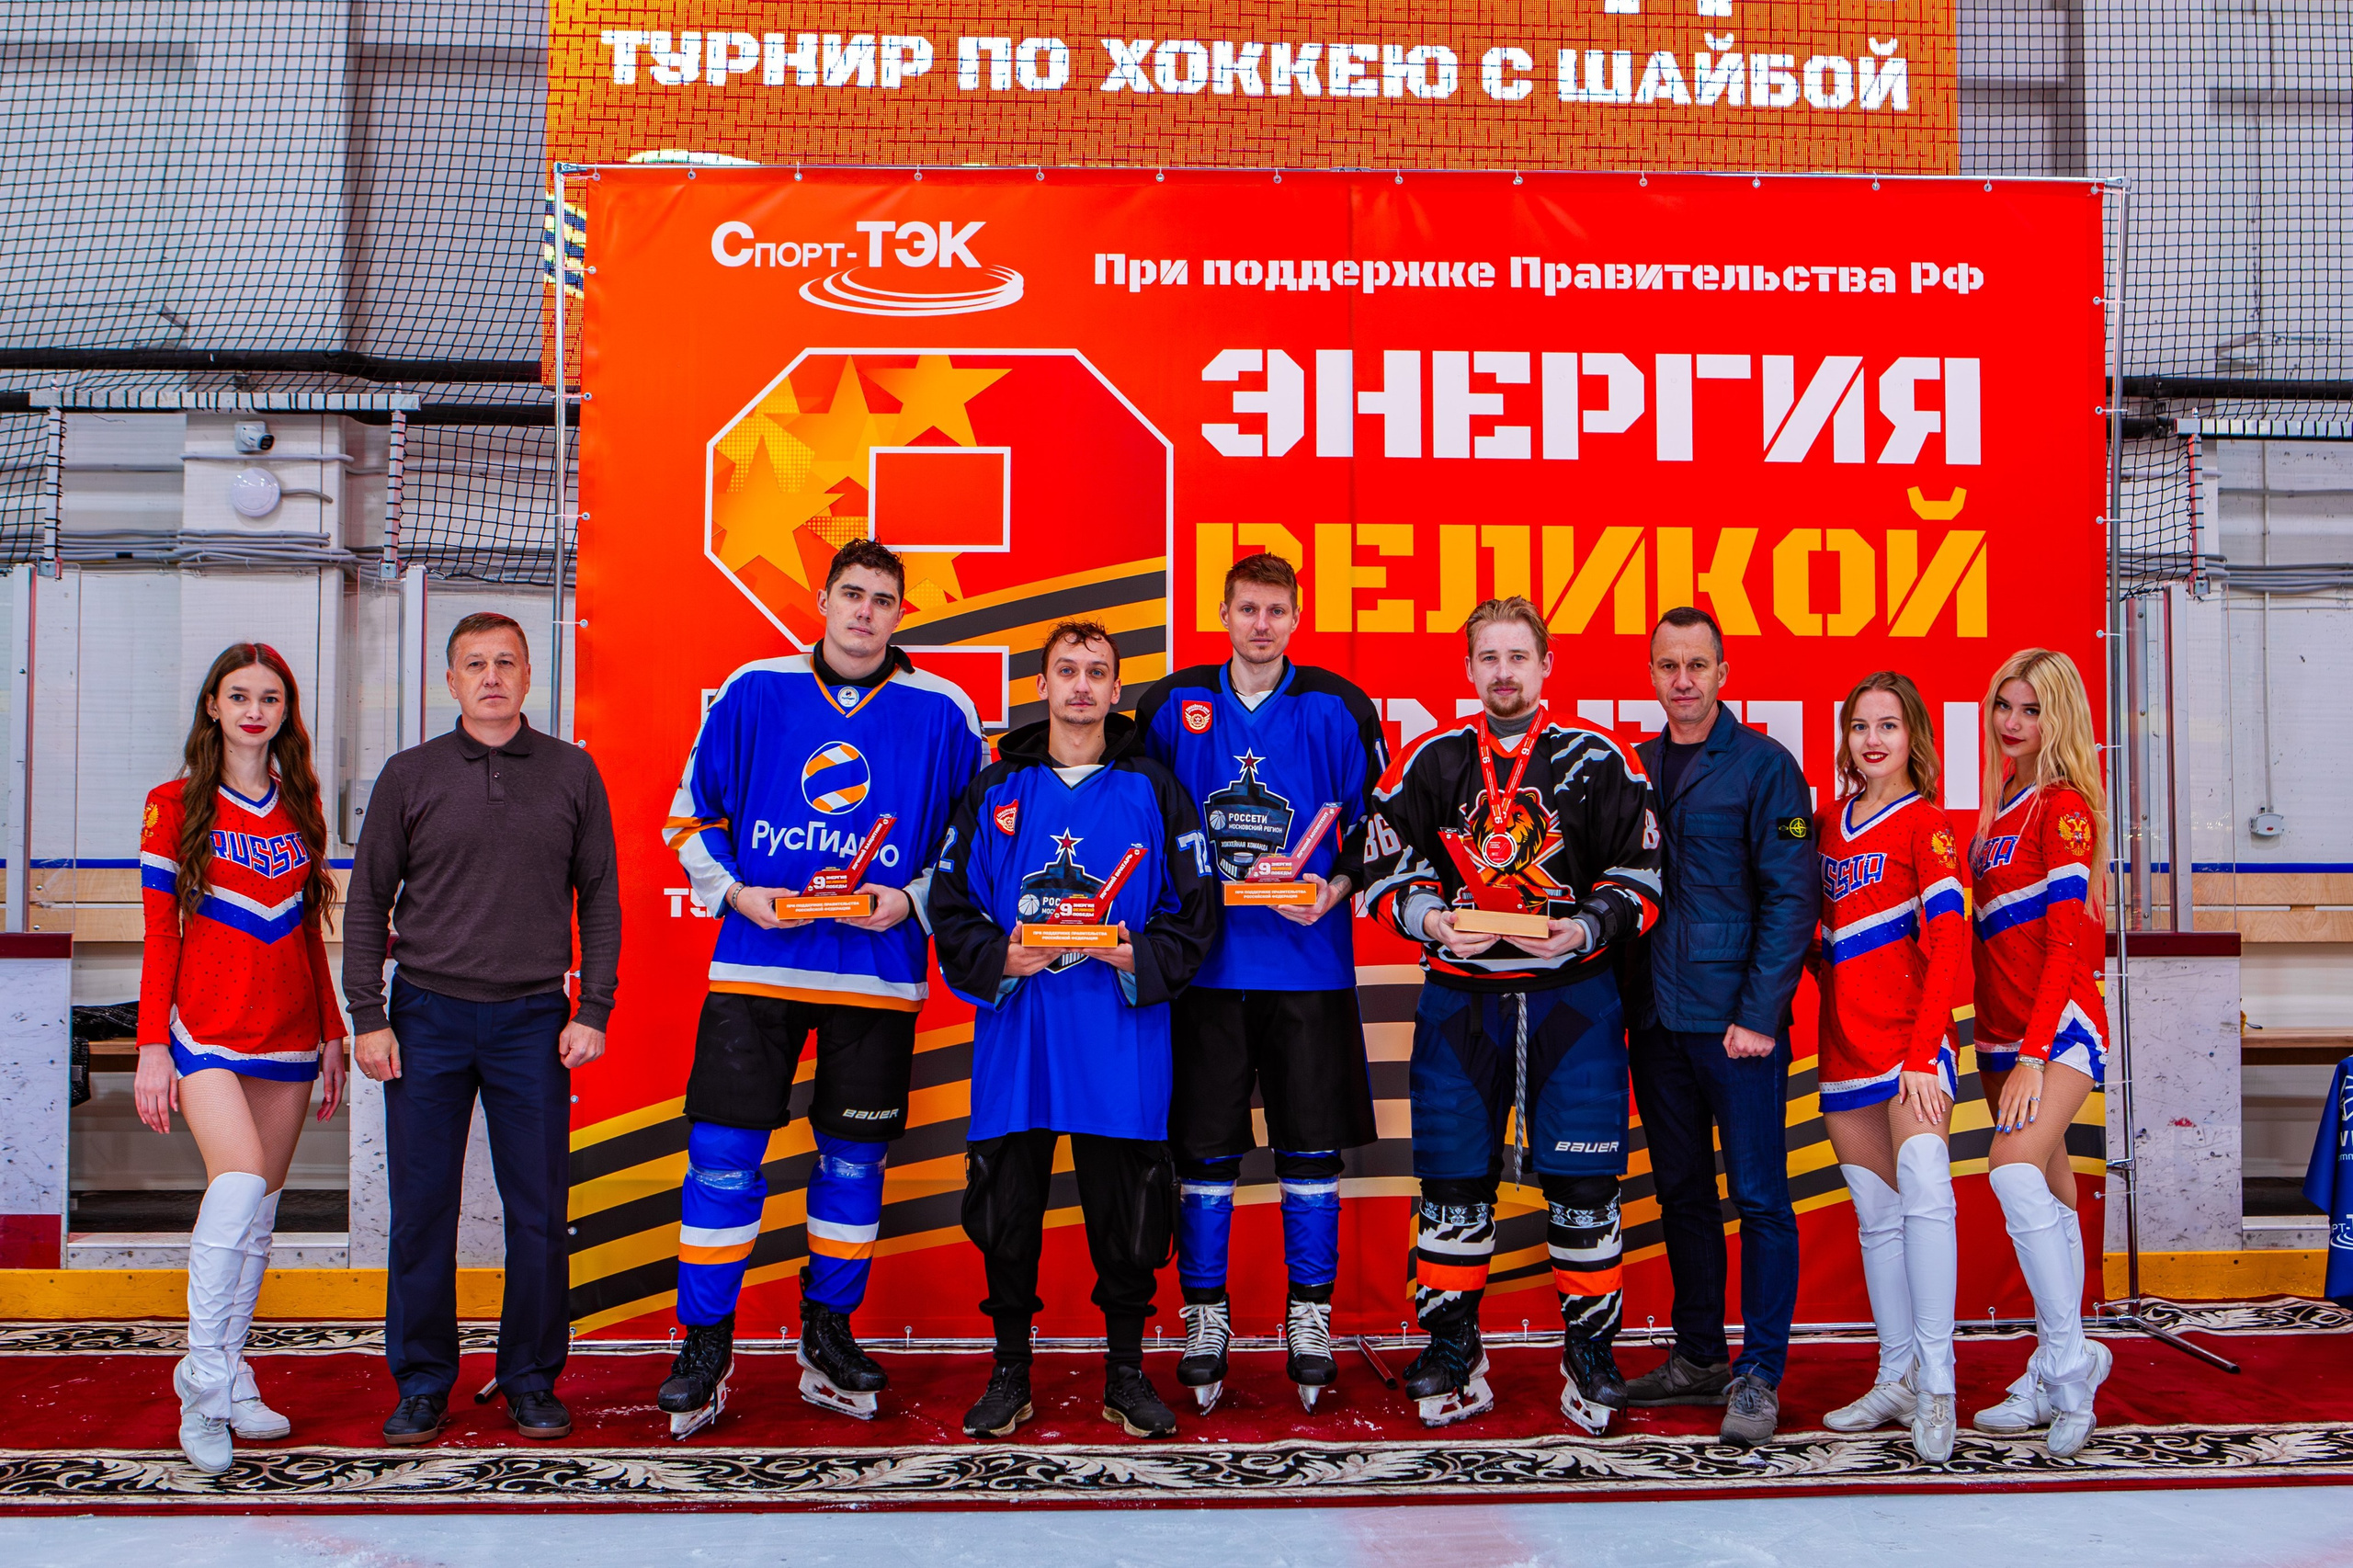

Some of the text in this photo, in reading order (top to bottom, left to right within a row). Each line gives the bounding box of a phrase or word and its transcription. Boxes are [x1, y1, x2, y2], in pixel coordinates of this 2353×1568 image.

[600, 30, 1909, 111] ТУРНИР ПО ХОККЕЮ С ШАЙБОЙ
[1095, 254, 1984, 297] При поддержке Правительства РФ
[1201, 348, 1982, 465] ЭНЕРГИЯ
[1196, 486, 1988, 638] ВЕЛИКОЙ
[1229, 813, 1267, 824] РОССЕТИ
[1363, 812, 1402, 864] 86
[813, 876, 826, 890] 9
[1100, 854, 1133, 900] ЛУЧШИЙ ВРАТАРЬ
[1258, 862, 1270, 875] 9
[1818, 852, 1888, 903] SSIA
[1060, 903, 1073, 916] 9
[842, 1108, 900, 1120] BAUER
[1555, 1142, 1620, 1153] BAUER
